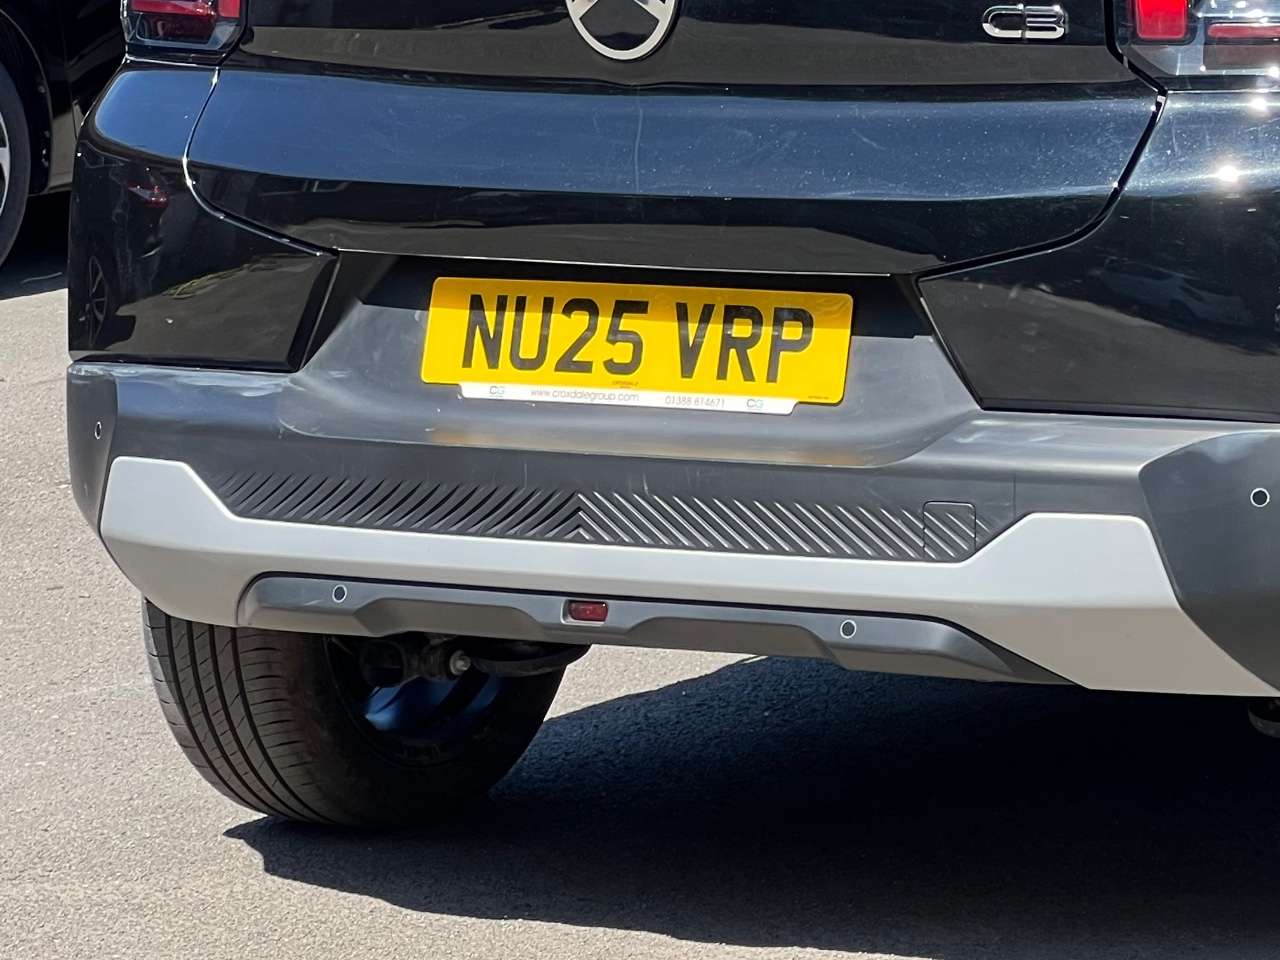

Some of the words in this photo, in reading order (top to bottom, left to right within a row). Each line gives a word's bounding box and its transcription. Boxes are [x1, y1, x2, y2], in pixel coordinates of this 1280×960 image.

[981, 3, 1067, 39] C3
[462, 294, 649, 376] NU25
[675, 302, 814, 384] VRP
